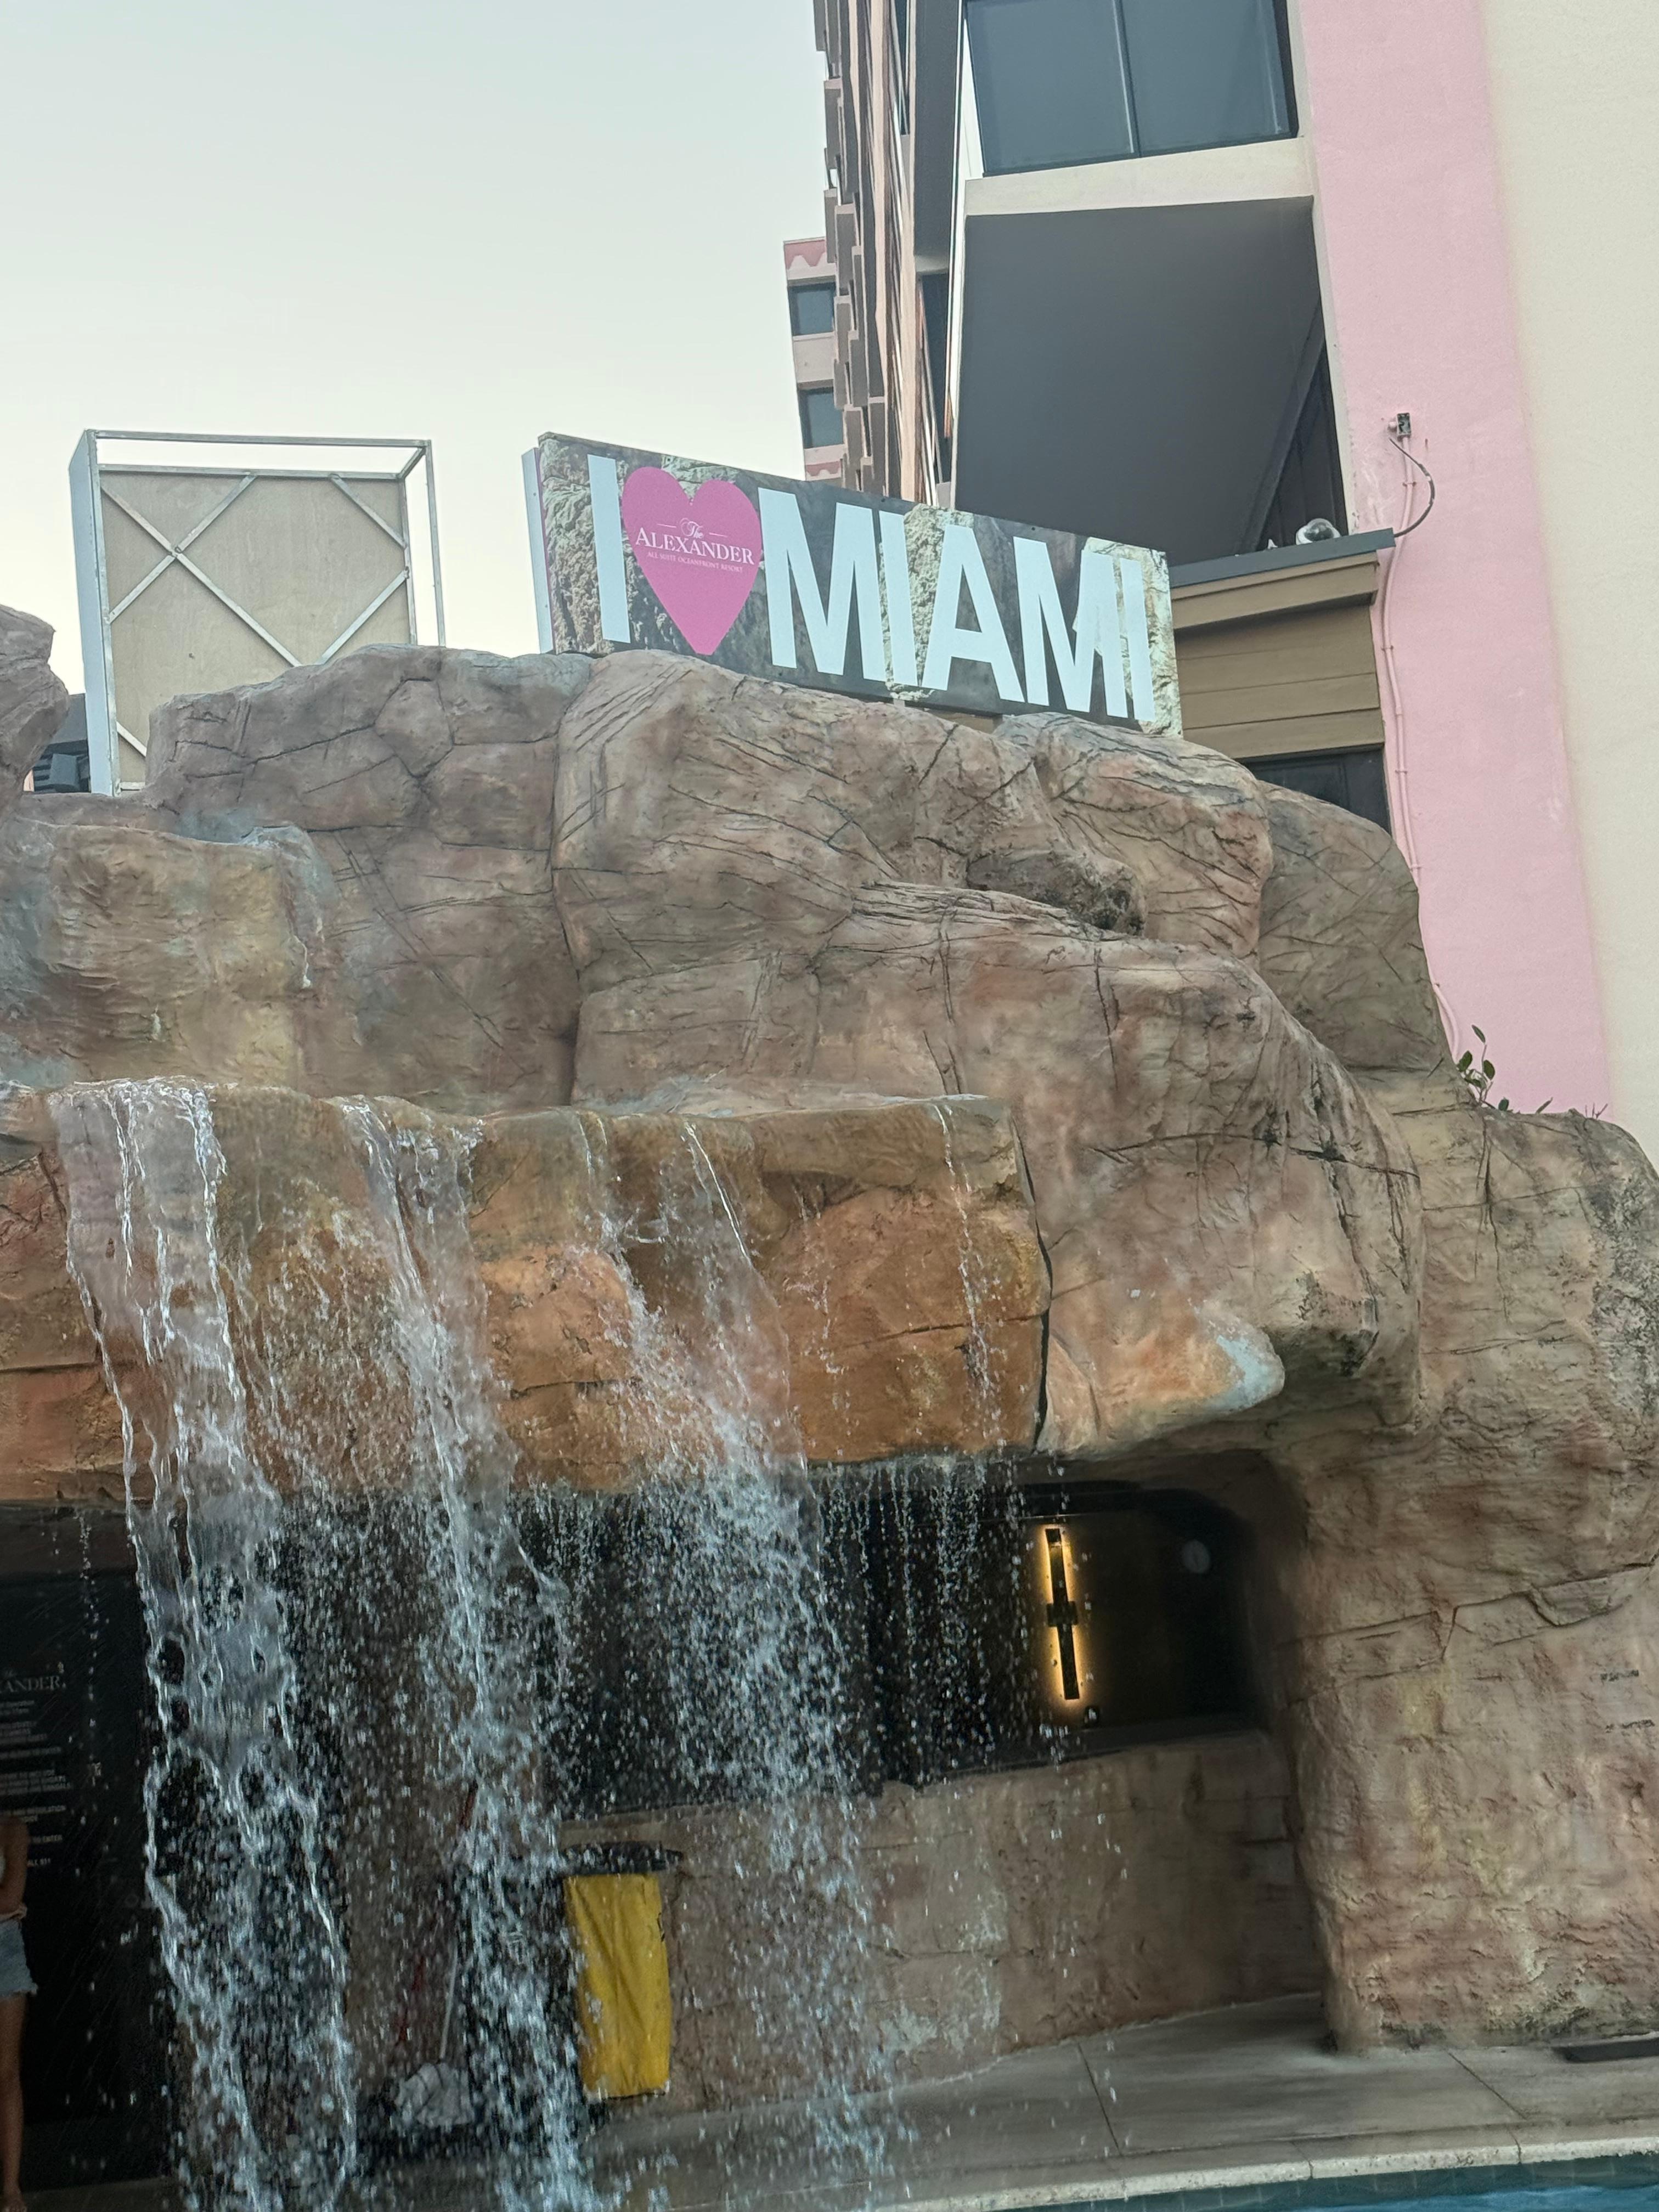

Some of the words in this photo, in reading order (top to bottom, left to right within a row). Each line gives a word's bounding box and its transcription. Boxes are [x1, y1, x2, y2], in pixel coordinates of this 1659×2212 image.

[680, 517, 704, 539] The
[635, 527, 754, 565] ALEXANDER
[586, 454, 631, 644] I
[758, 487, 1155, 722] MIAMI
[0, 1675, 60, 1694] ANDER
